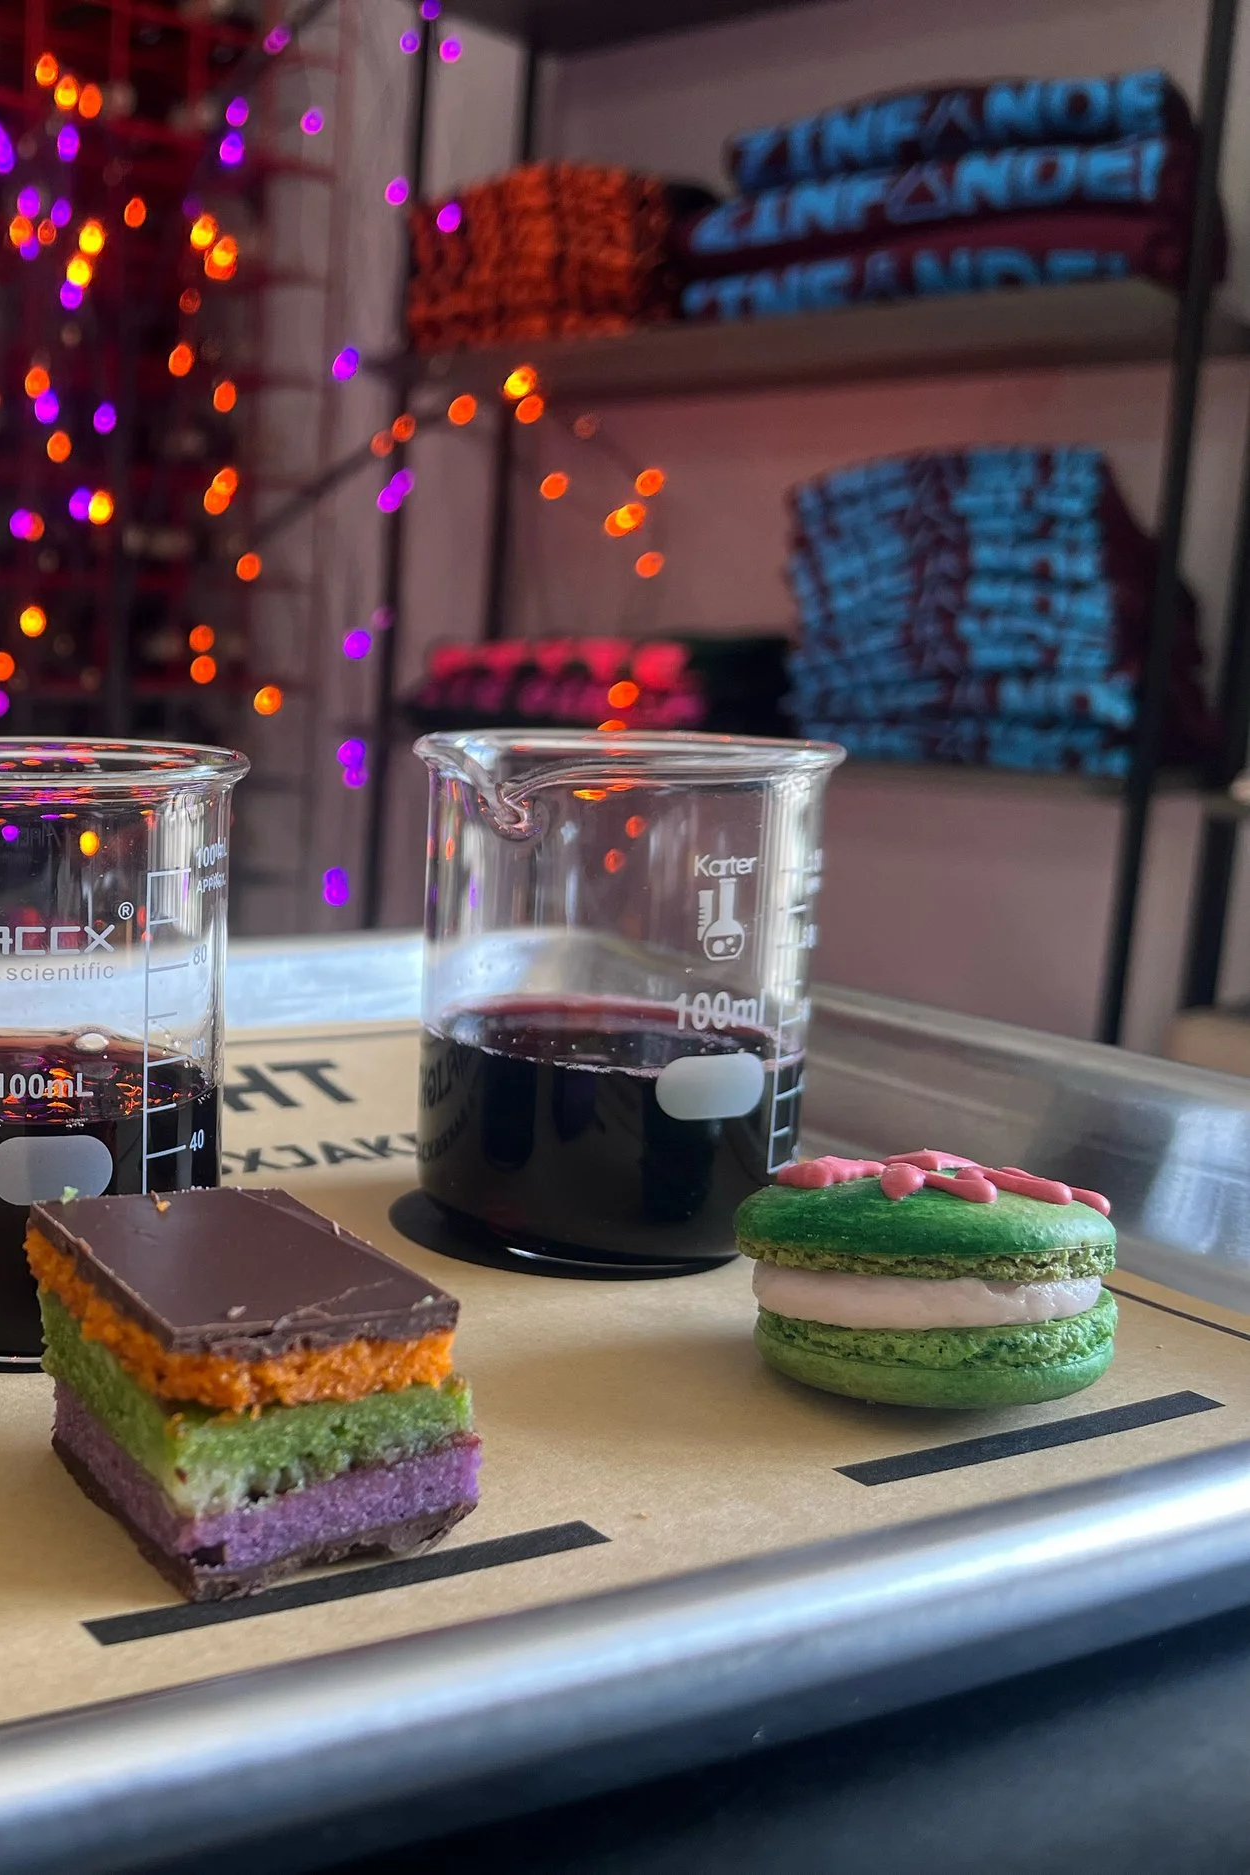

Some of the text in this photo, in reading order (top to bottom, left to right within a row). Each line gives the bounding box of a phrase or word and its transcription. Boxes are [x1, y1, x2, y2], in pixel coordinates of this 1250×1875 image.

[693, 853, 759, 878] Karter
[192, 943, 208, 966] 80
[189, 1128, 205, 1152] 40
